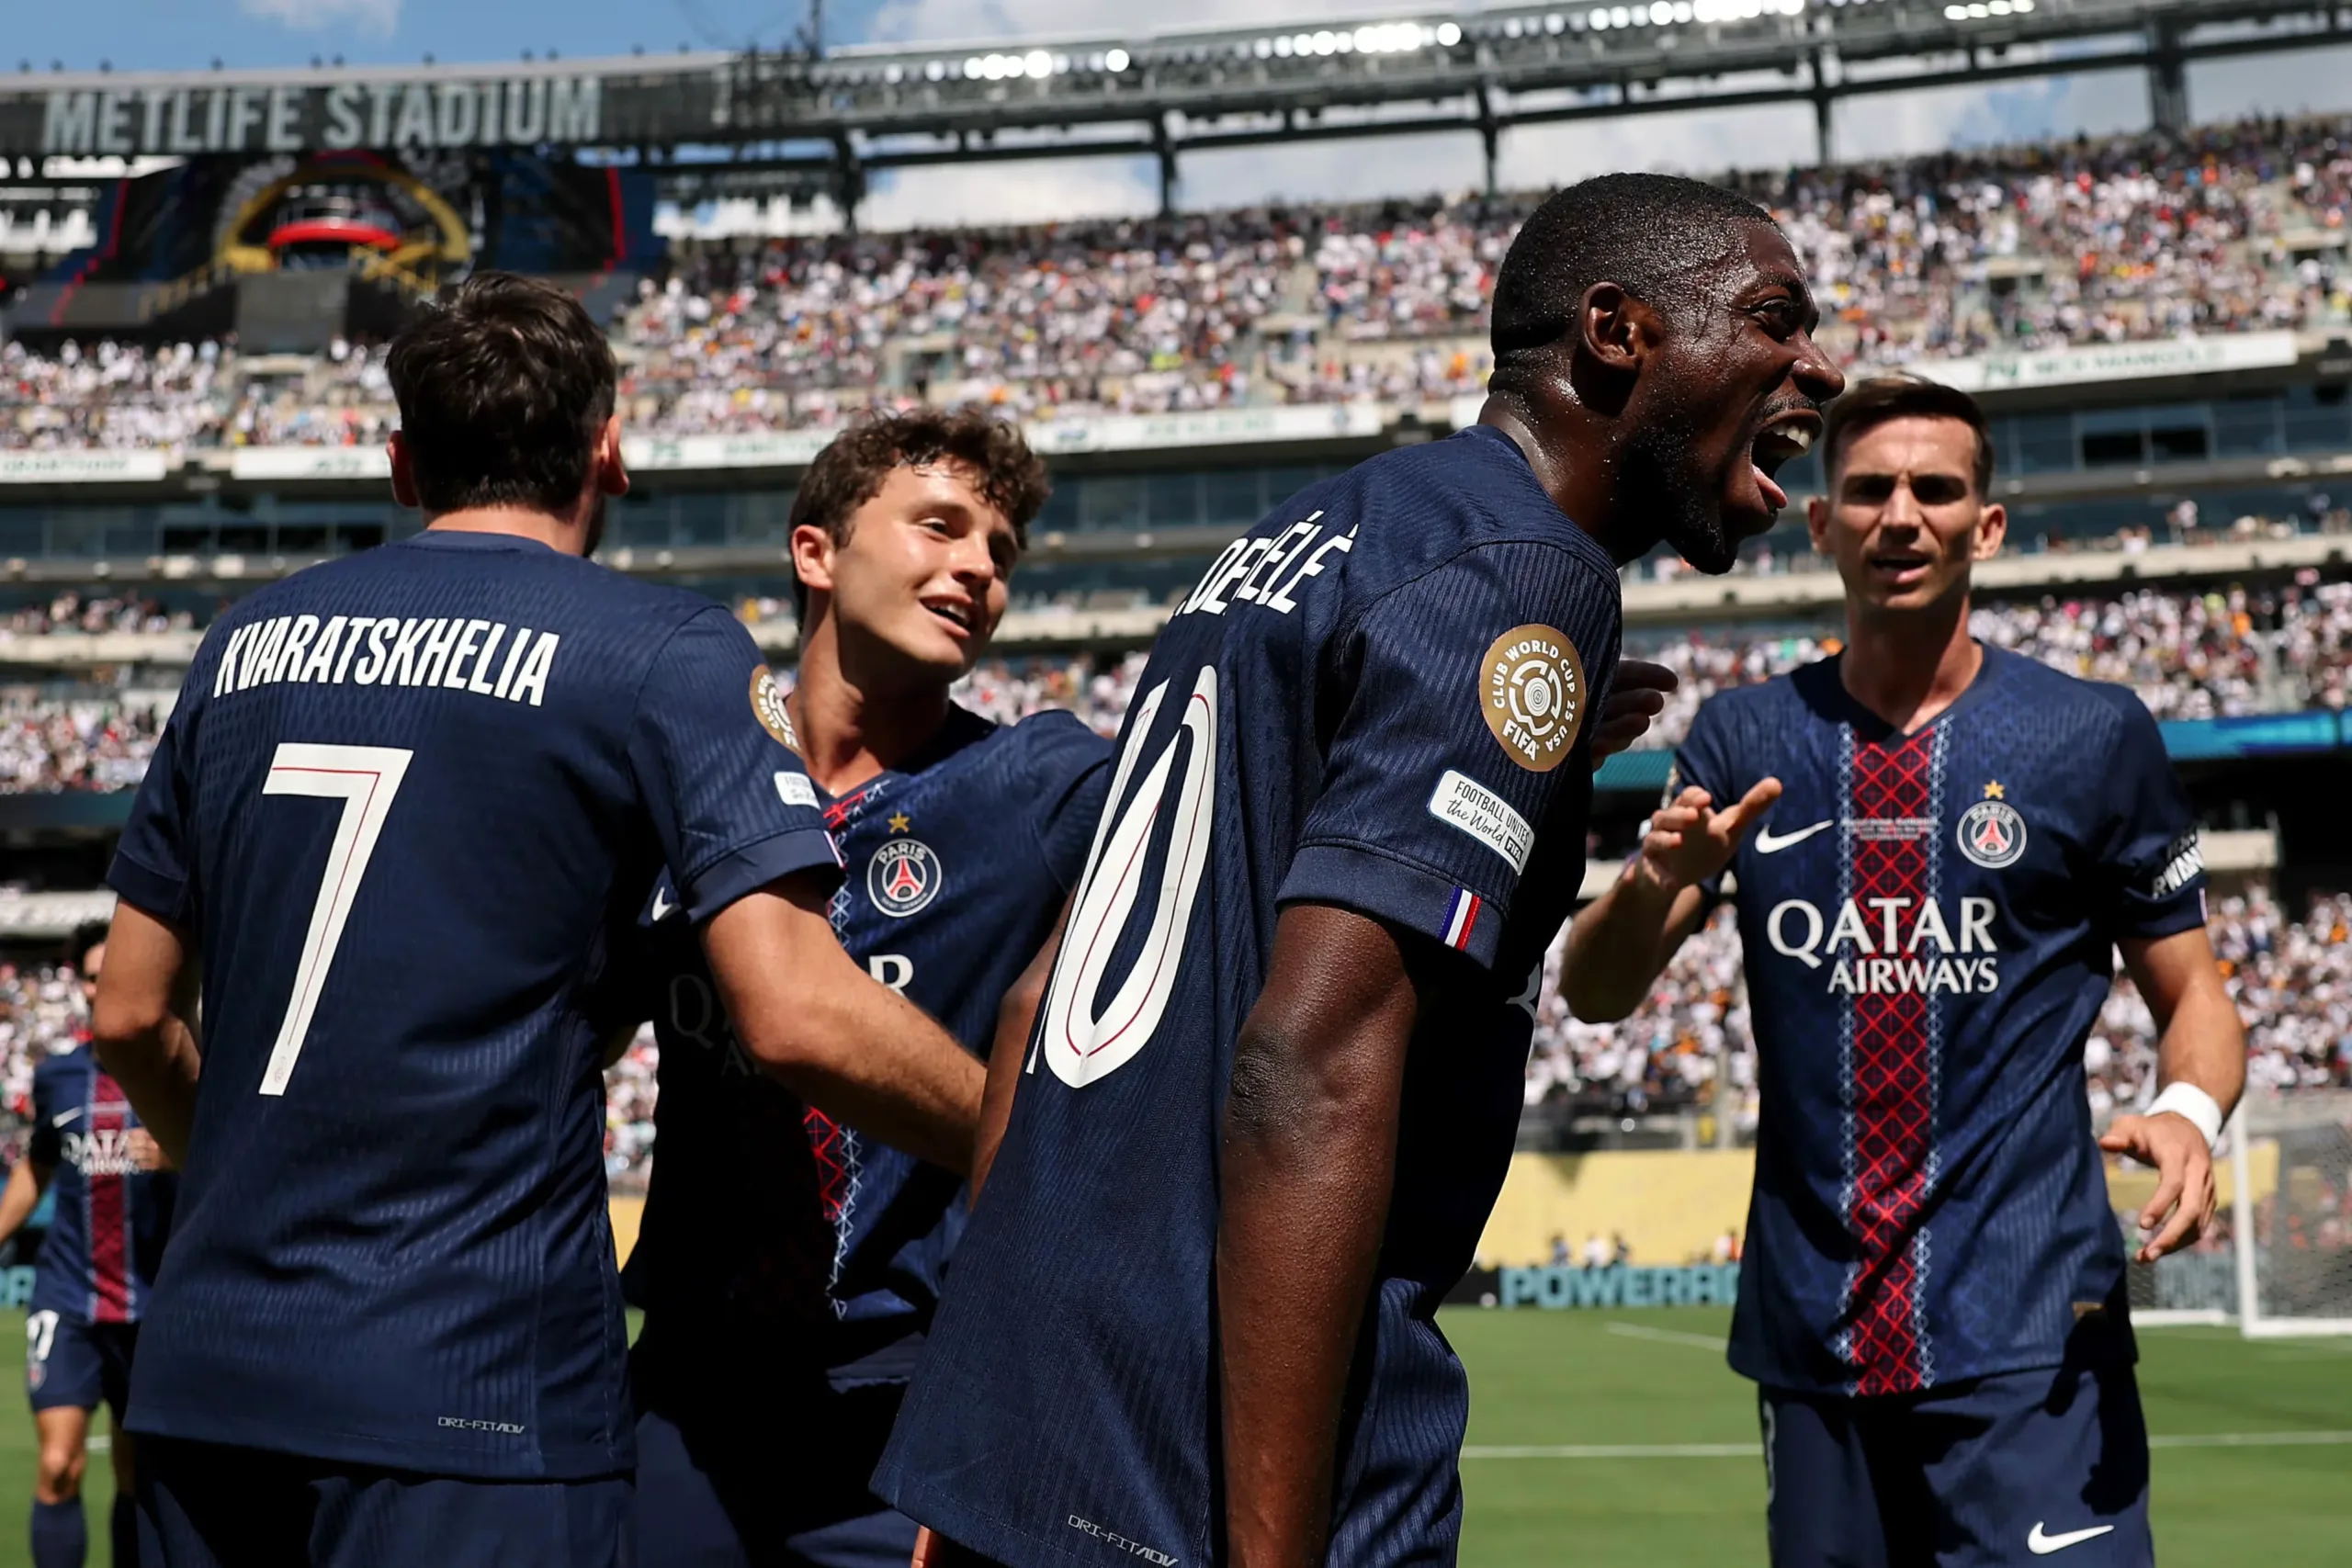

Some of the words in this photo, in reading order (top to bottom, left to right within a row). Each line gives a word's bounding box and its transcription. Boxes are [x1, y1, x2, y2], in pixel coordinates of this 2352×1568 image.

[41, 90, 304, 154] METLIFE
[322, 75, 602, 150] STADIUM
[213, 615, 560, 706] KVARATSKHELIA
[1505, 640, 1559, 661] WORLD
[1492, 661, 1509, 708] CLUB
[1560, 659, 1575, 693] CUP
[1565, 700, 1575, 722] 25
[1502, 718, 1536, 761] FIFA
[1545, 725, 1567, 751] USA
[1447, 799, 1469, 819] the
[1470, 810, 1507, 846] World
[1454, 781, 1505, 822] FOOTBALL
[1506, 813, 1529, 845] UNITES
[878, 842, 927, 864] PARIS
[1507, 842, 1521, 862] FIFA
[1026, 665, 1217, 1089] 10
[258, 742, 413, 1097] 7
[1767, 897, 1998, 969] QATAR
[1827, 957, 1998, 994] AIRWAYS
[1500, 1265, 1740, 1308] POWERA
